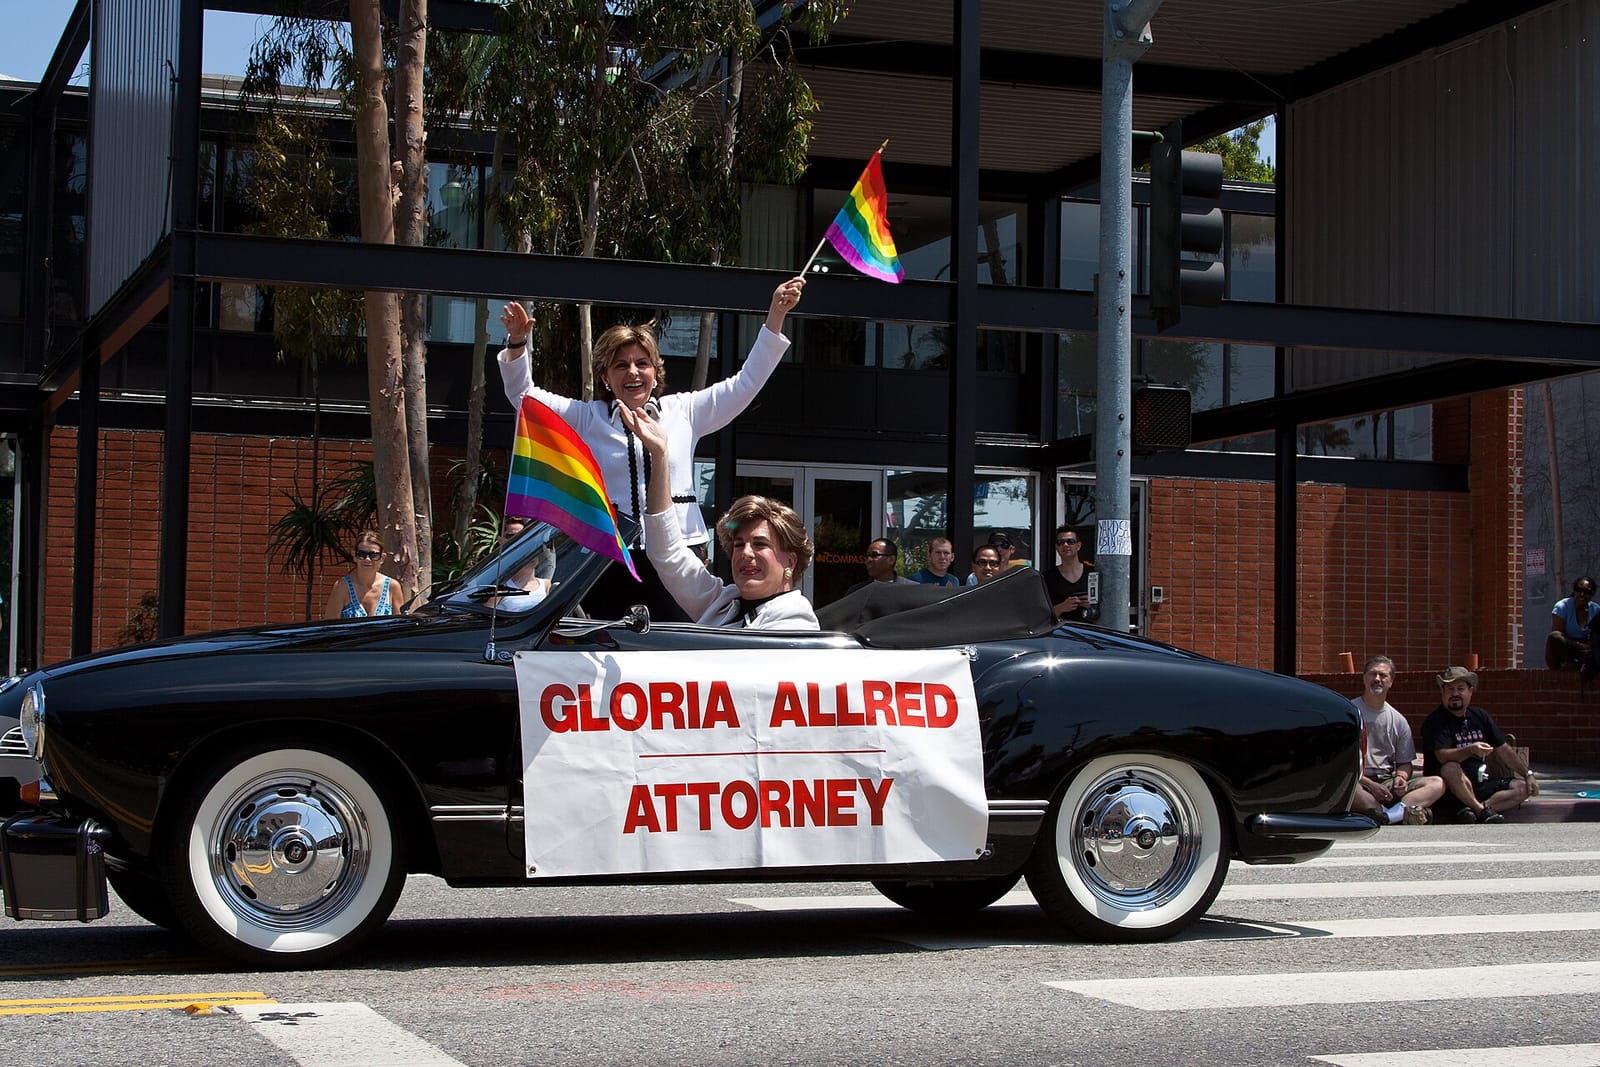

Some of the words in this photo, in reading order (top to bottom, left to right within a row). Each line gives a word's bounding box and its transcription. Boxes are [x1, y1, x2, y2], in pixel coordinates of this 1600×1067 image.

[541, 681, 739, 733] GLORIA
[770, 680, 958, 728] ALLRED
[624, 779, 892, 833] ATTORNEY
